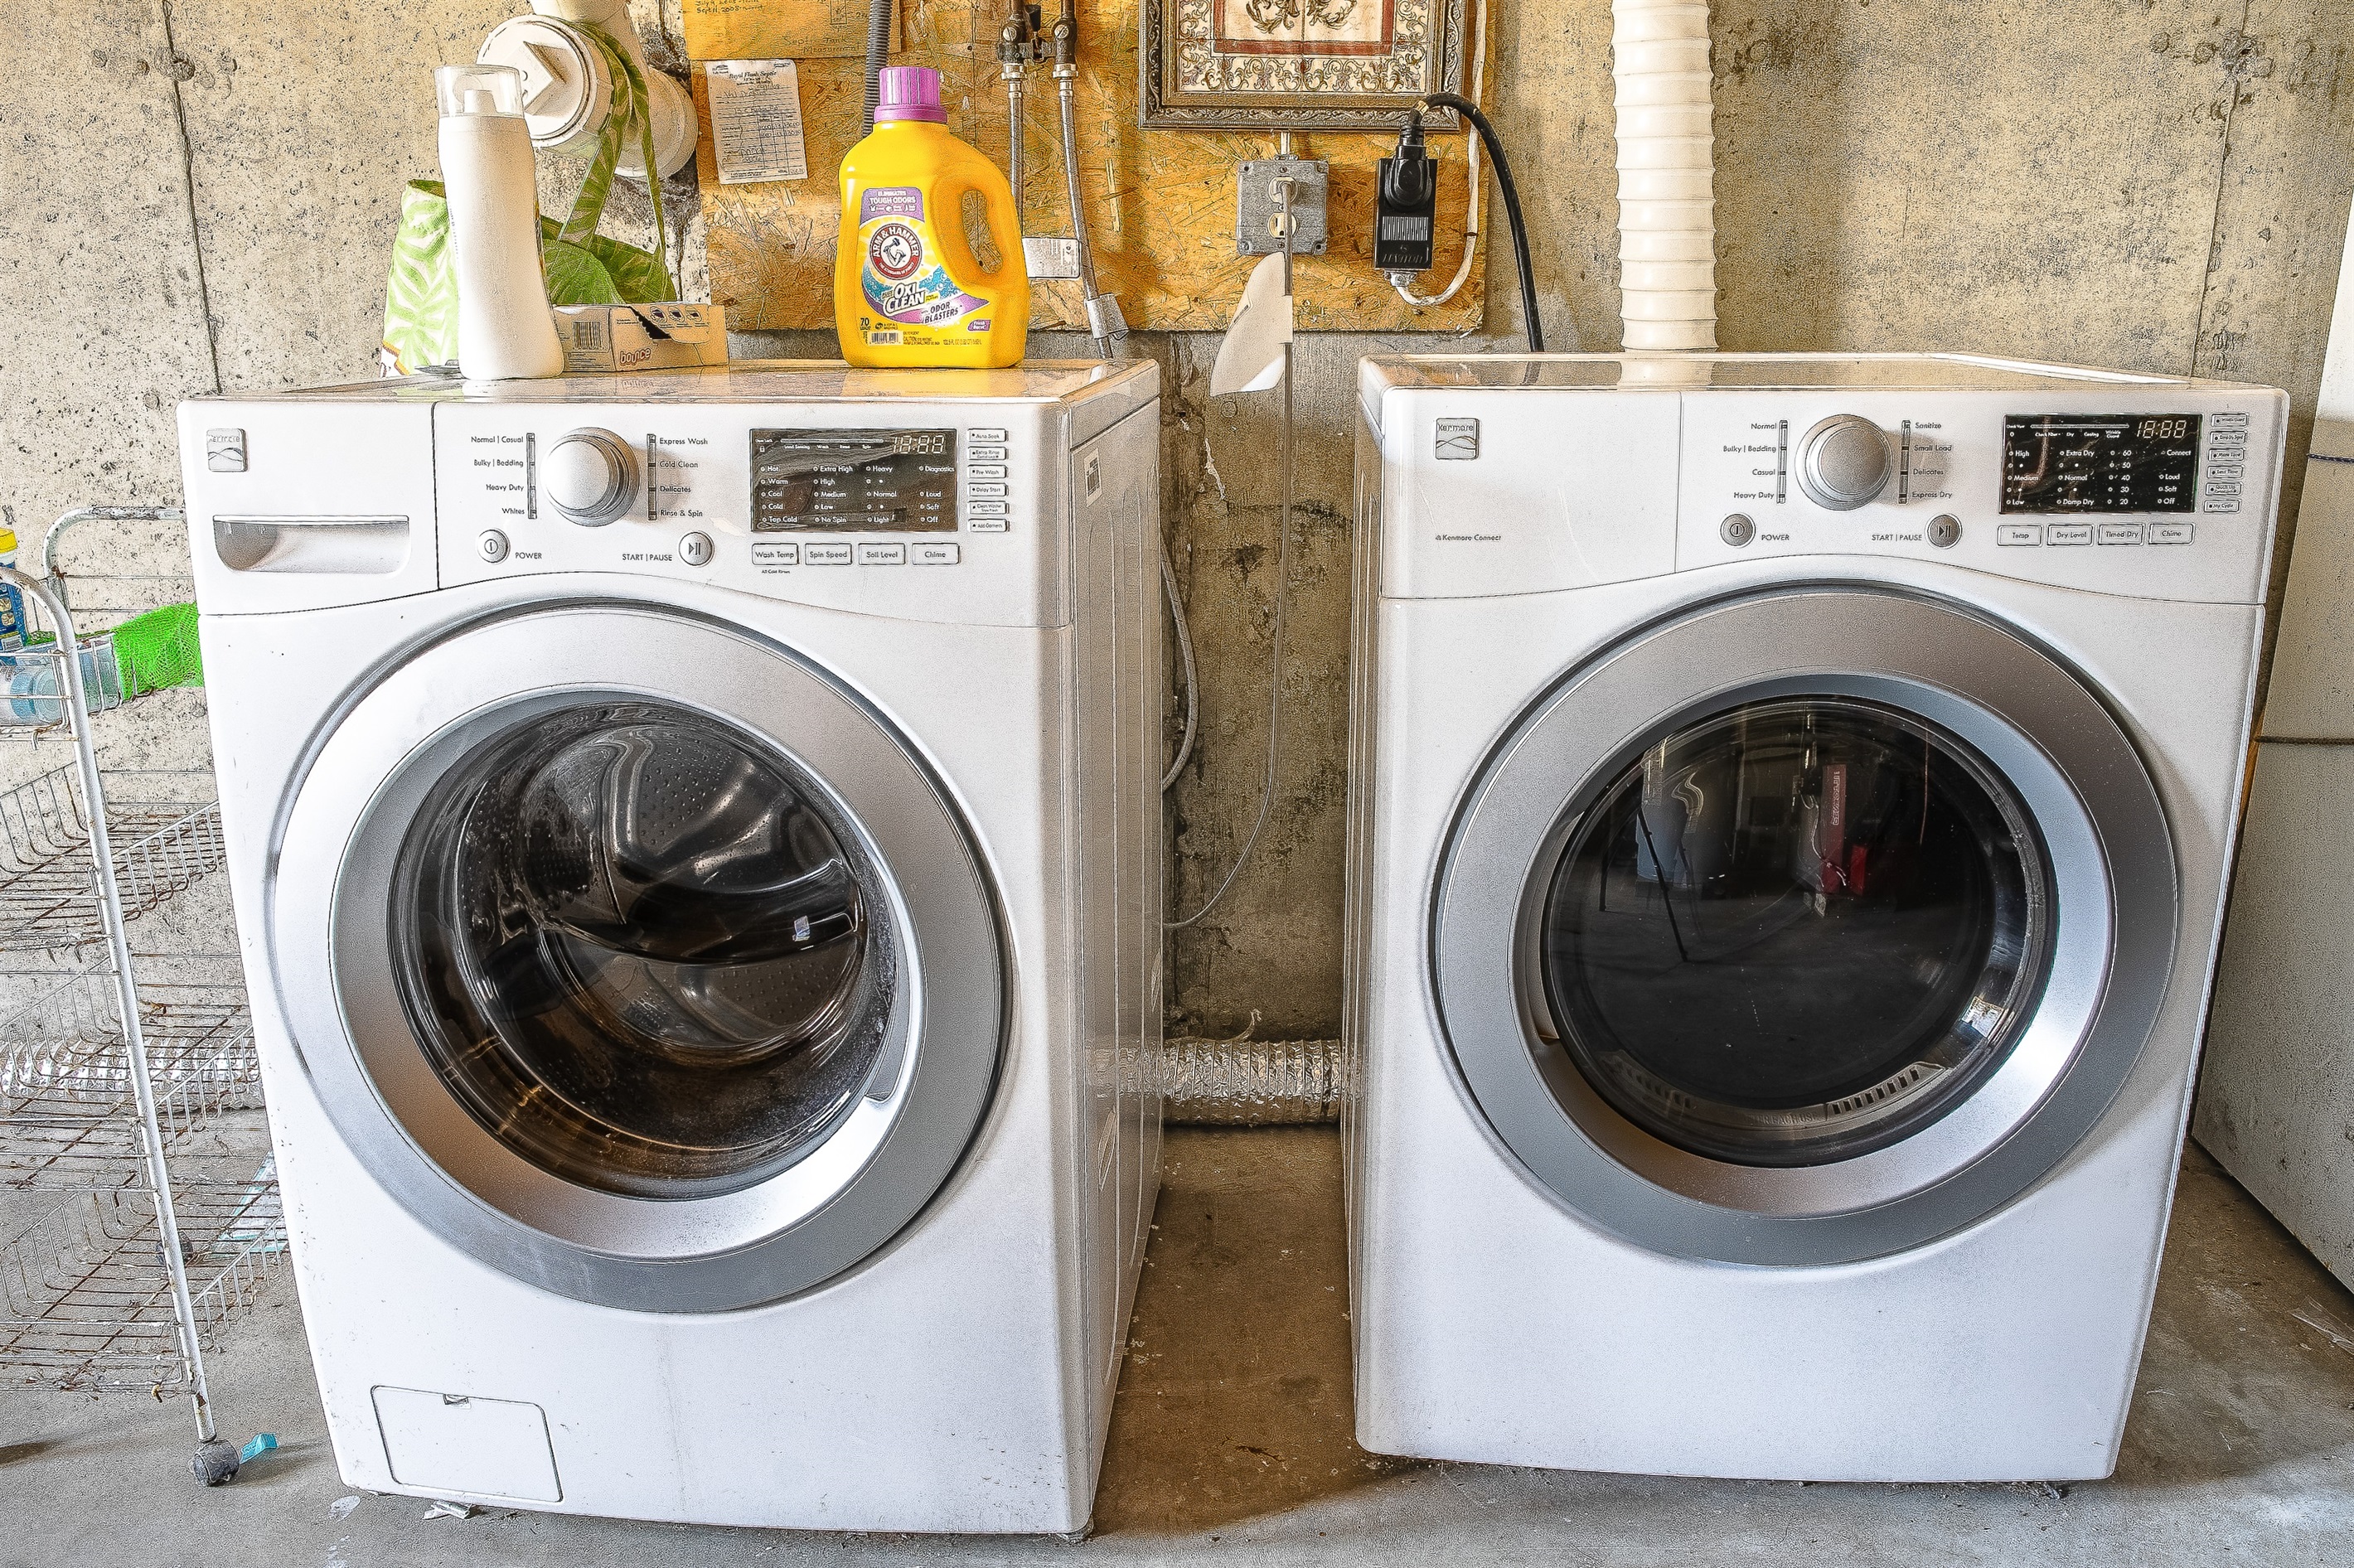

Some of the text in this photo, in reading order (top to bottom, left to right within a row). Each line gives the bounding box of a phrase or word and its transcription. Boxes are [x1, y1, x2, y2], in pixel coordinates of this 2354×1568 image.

[873, 235, 884, 257] ARM
[889, 226, 919, 257] HAMMER
[894, 283, 918, 298] OXI
[884, 291, 925, 314] CLEAN
[930, 302, 951, 313] ODOR
[924, 307, 958, 323] BLASTERS
[860, 317, 869, 326] 70
[620, 348, 651, 365] bounce
[1438, 423, 1474, 432] Kenmore
[2136, 420, 2187, 438] 18:88
[659, 438, 686, 446] Express
[1723, 445, 1776, 453] Bulky Bedding
[2015, 450, 2030, 458] High
[473, 459, 524, 467] Bulky Bedding
[838, 466, 853, 474] High
[873, 466, 893, 474] Heavy
[925, 466, 955, 474] Diagnostics
[821, 478, 836, 486] High
[486, 484, 507, 492] Heavy
[1760, 491, 1775, 500] Duty
[1911, 491, 1953, 500] Express Dry
[687, 510, 703, 518] Spin
[768, 516, 781, 525] Tap
[831, 516, 847, 525] Spin
[874, 516, 889, 525] Light
[2056, 531, 2070, 540] Dry
[777, 551, 794, 559] Temp
[809, 551, 847, 559] Spin Speed
